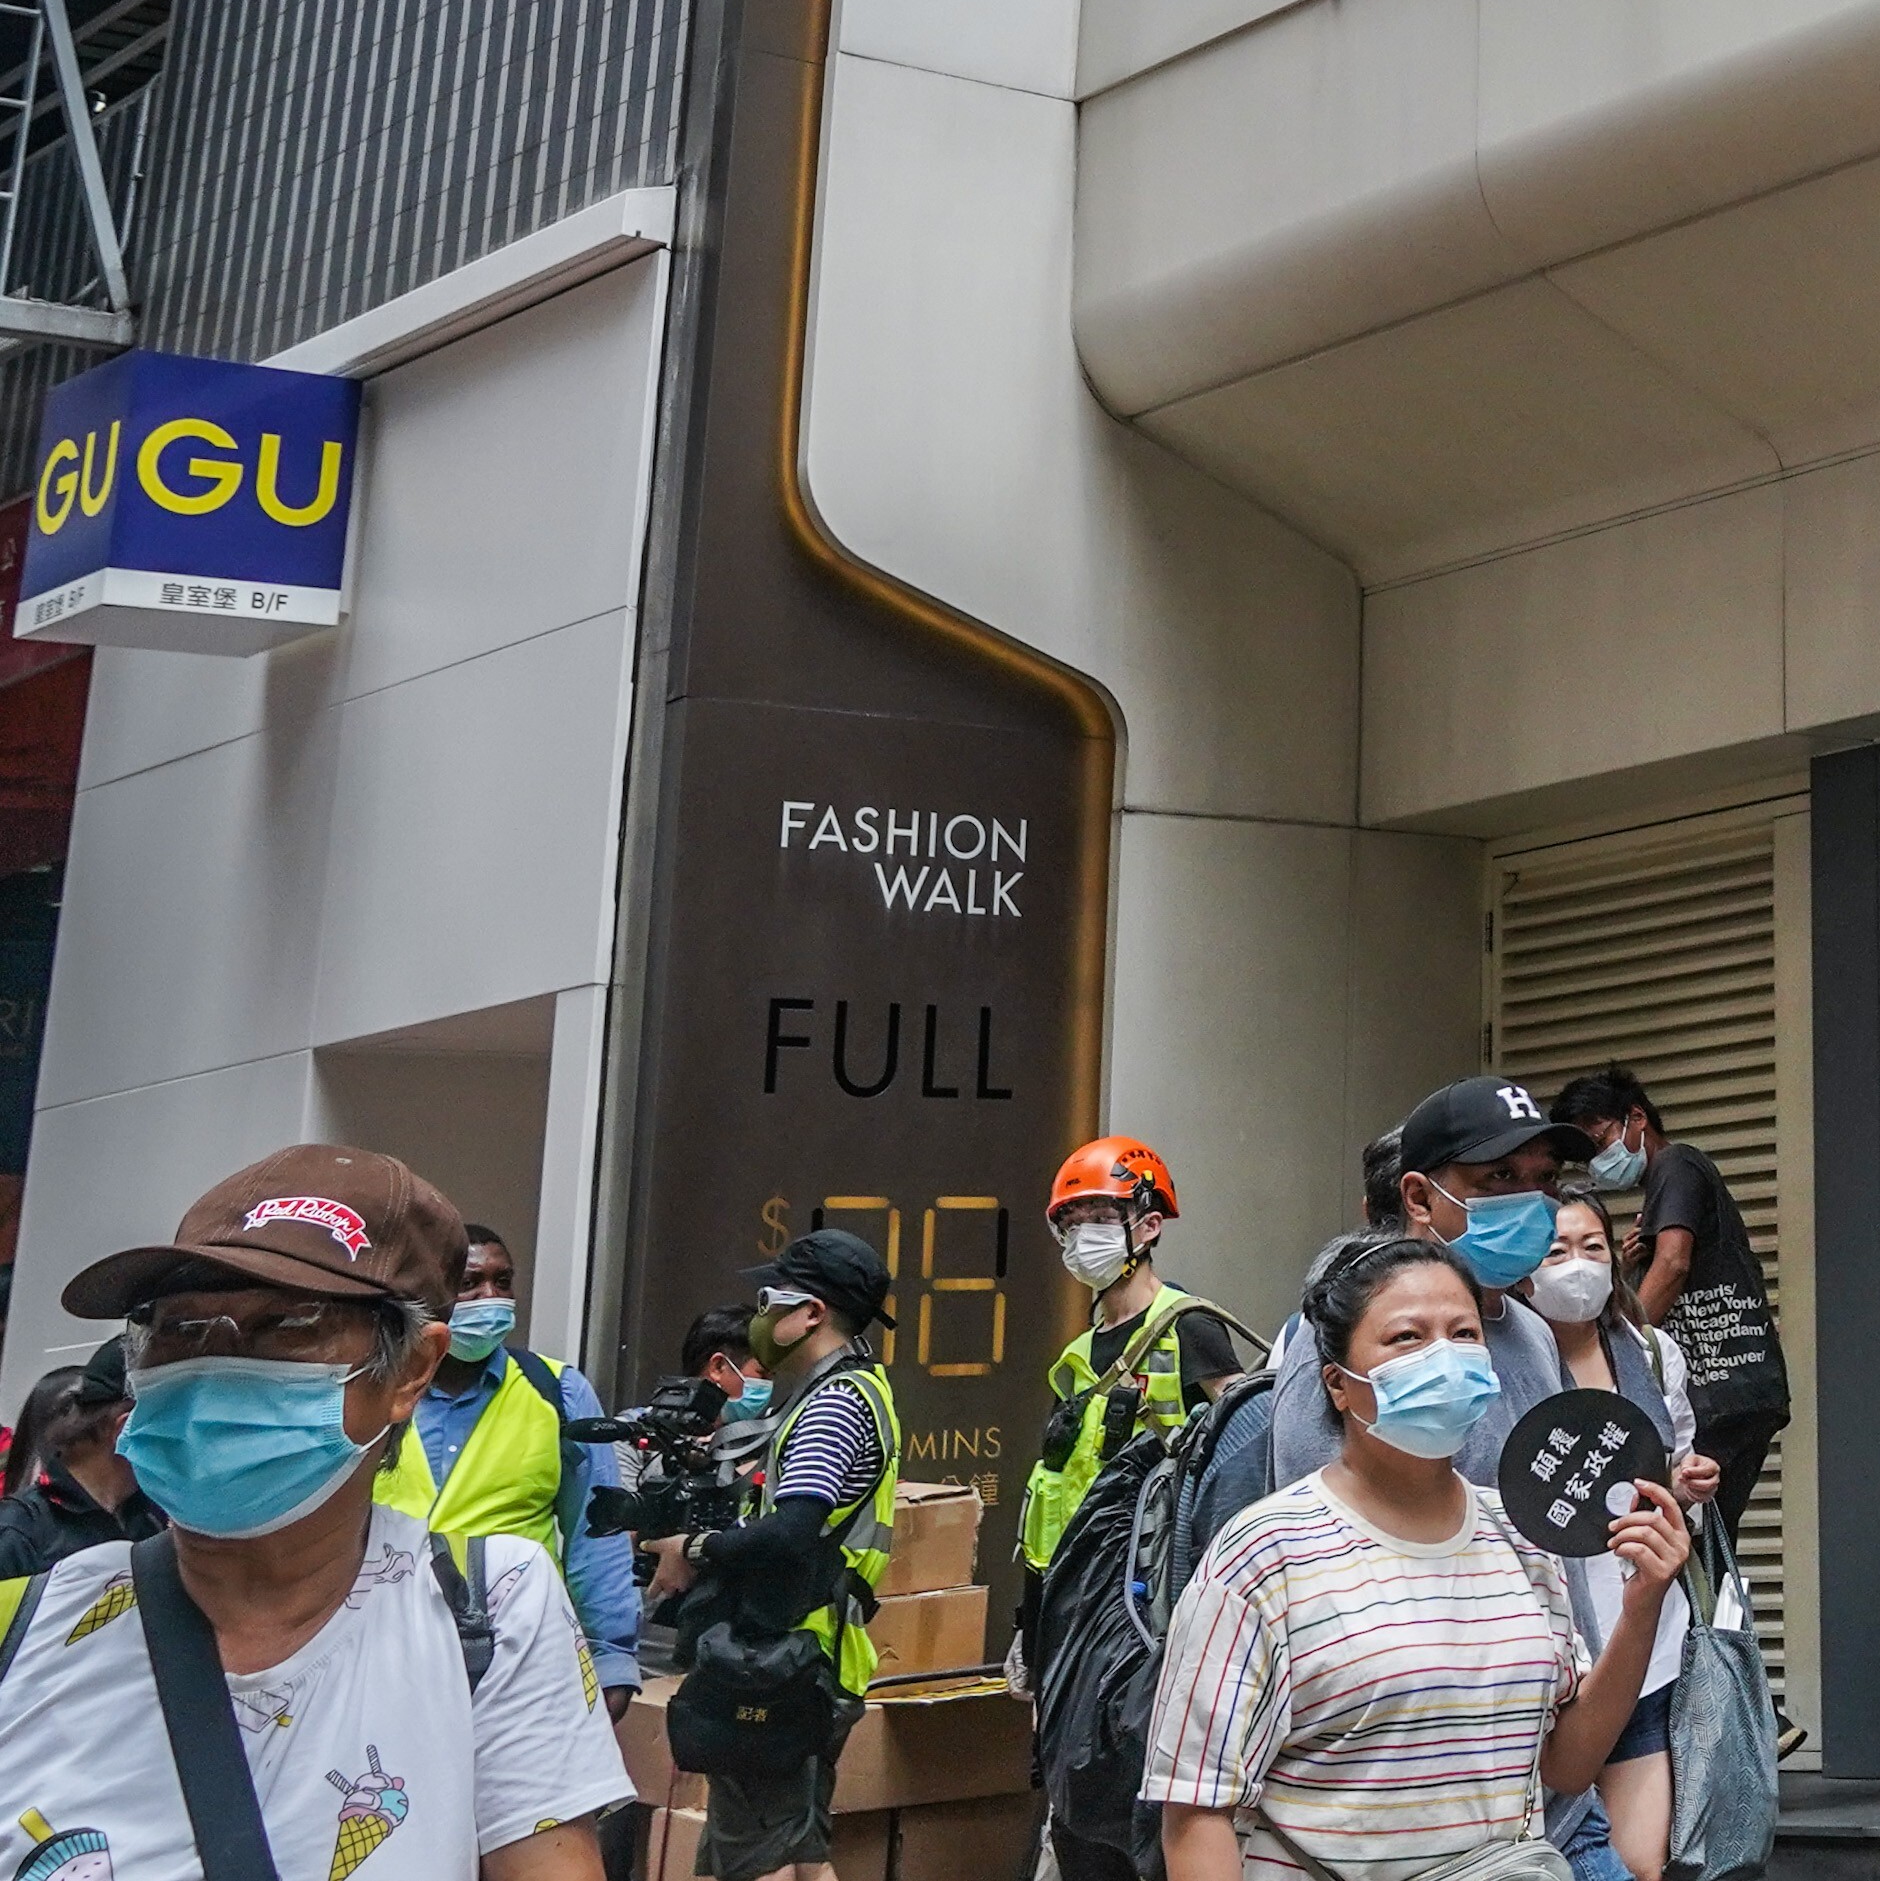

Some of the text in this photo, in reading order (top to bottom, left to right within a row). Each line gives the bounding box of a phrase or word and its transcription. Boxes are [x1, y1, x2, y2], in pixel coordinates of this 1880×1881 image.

[36, 420, 121, 535] GU
[136, 417, 343, 527] GU
[159, 582, 289, 612] 皇室堡 B/F
[779, 800, 1028, 863] FASHION
[873, 861, 1024, 918] WALK
[763, 997, 1013, 1101] FULL
[1497, 1086, 1542, 1119] H
[263, 1199, 354, 1232] Red Ribbon
[906, 1426, 1001, 1461] MINS
[1546, 1421, 1630, 1528] 國家政權
